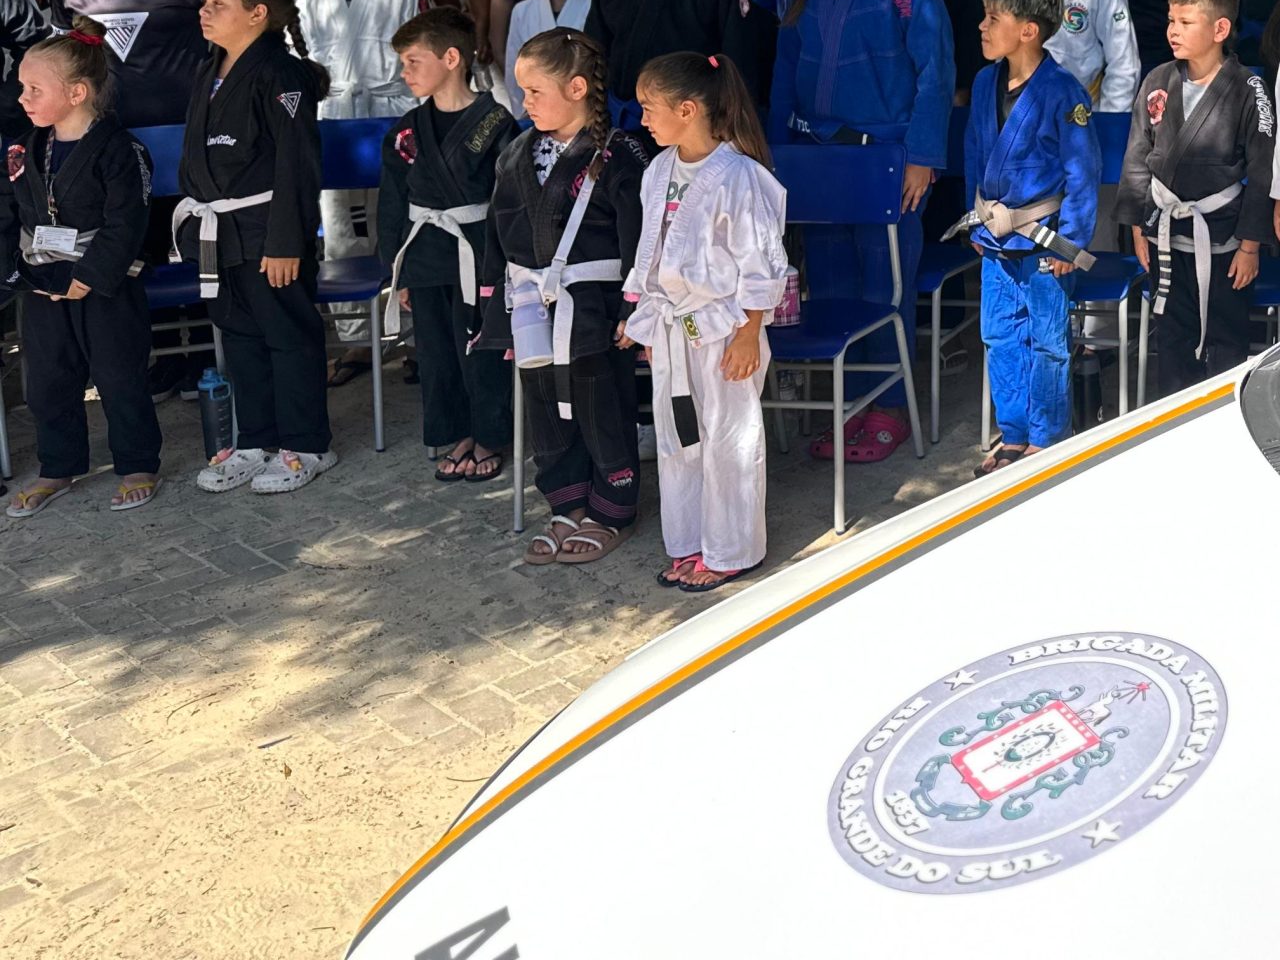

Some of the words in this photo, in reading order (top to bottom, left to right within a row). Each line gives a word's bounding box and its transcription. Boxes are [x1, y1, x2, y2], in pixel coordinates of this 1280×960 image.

[864, 696, 931, 753] RIO
[1008, 635, 1189, 676] BRIGADA
[1142, 669, 1219, 800] MILITAR
[838, 756, 896, 868] GRANDE
[884, 790, 932, 836] 1837
[885, 853, 951, 884] DO
[955, 848, 1064, 885] SUL
